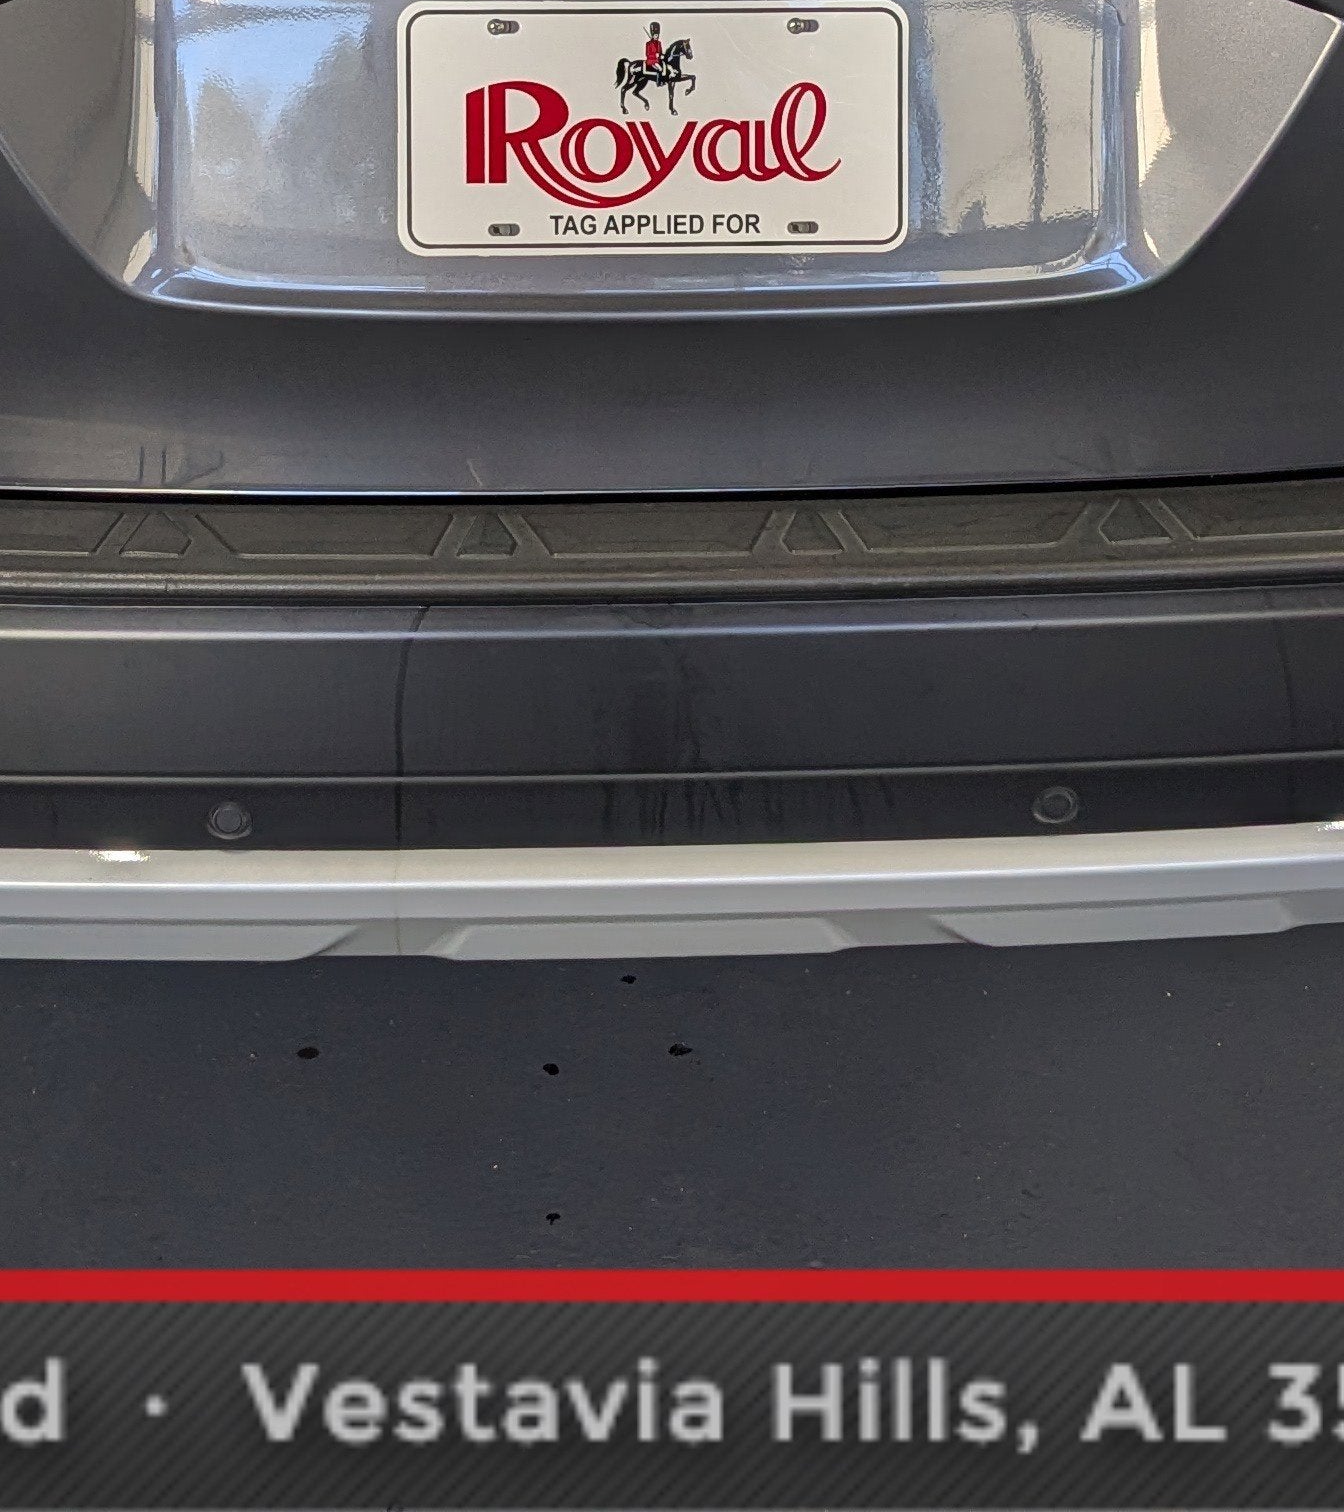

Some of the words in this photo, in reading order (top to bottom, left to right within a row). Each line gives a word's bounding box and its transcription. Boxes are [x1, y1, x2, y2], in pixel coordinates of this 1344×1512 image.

[465, 80, 842, 209] Royal
[550, 214, 597, 235] TAG
[603, 214, 704, 235] APPLIED
[712, 213, 761, 234] FOR
